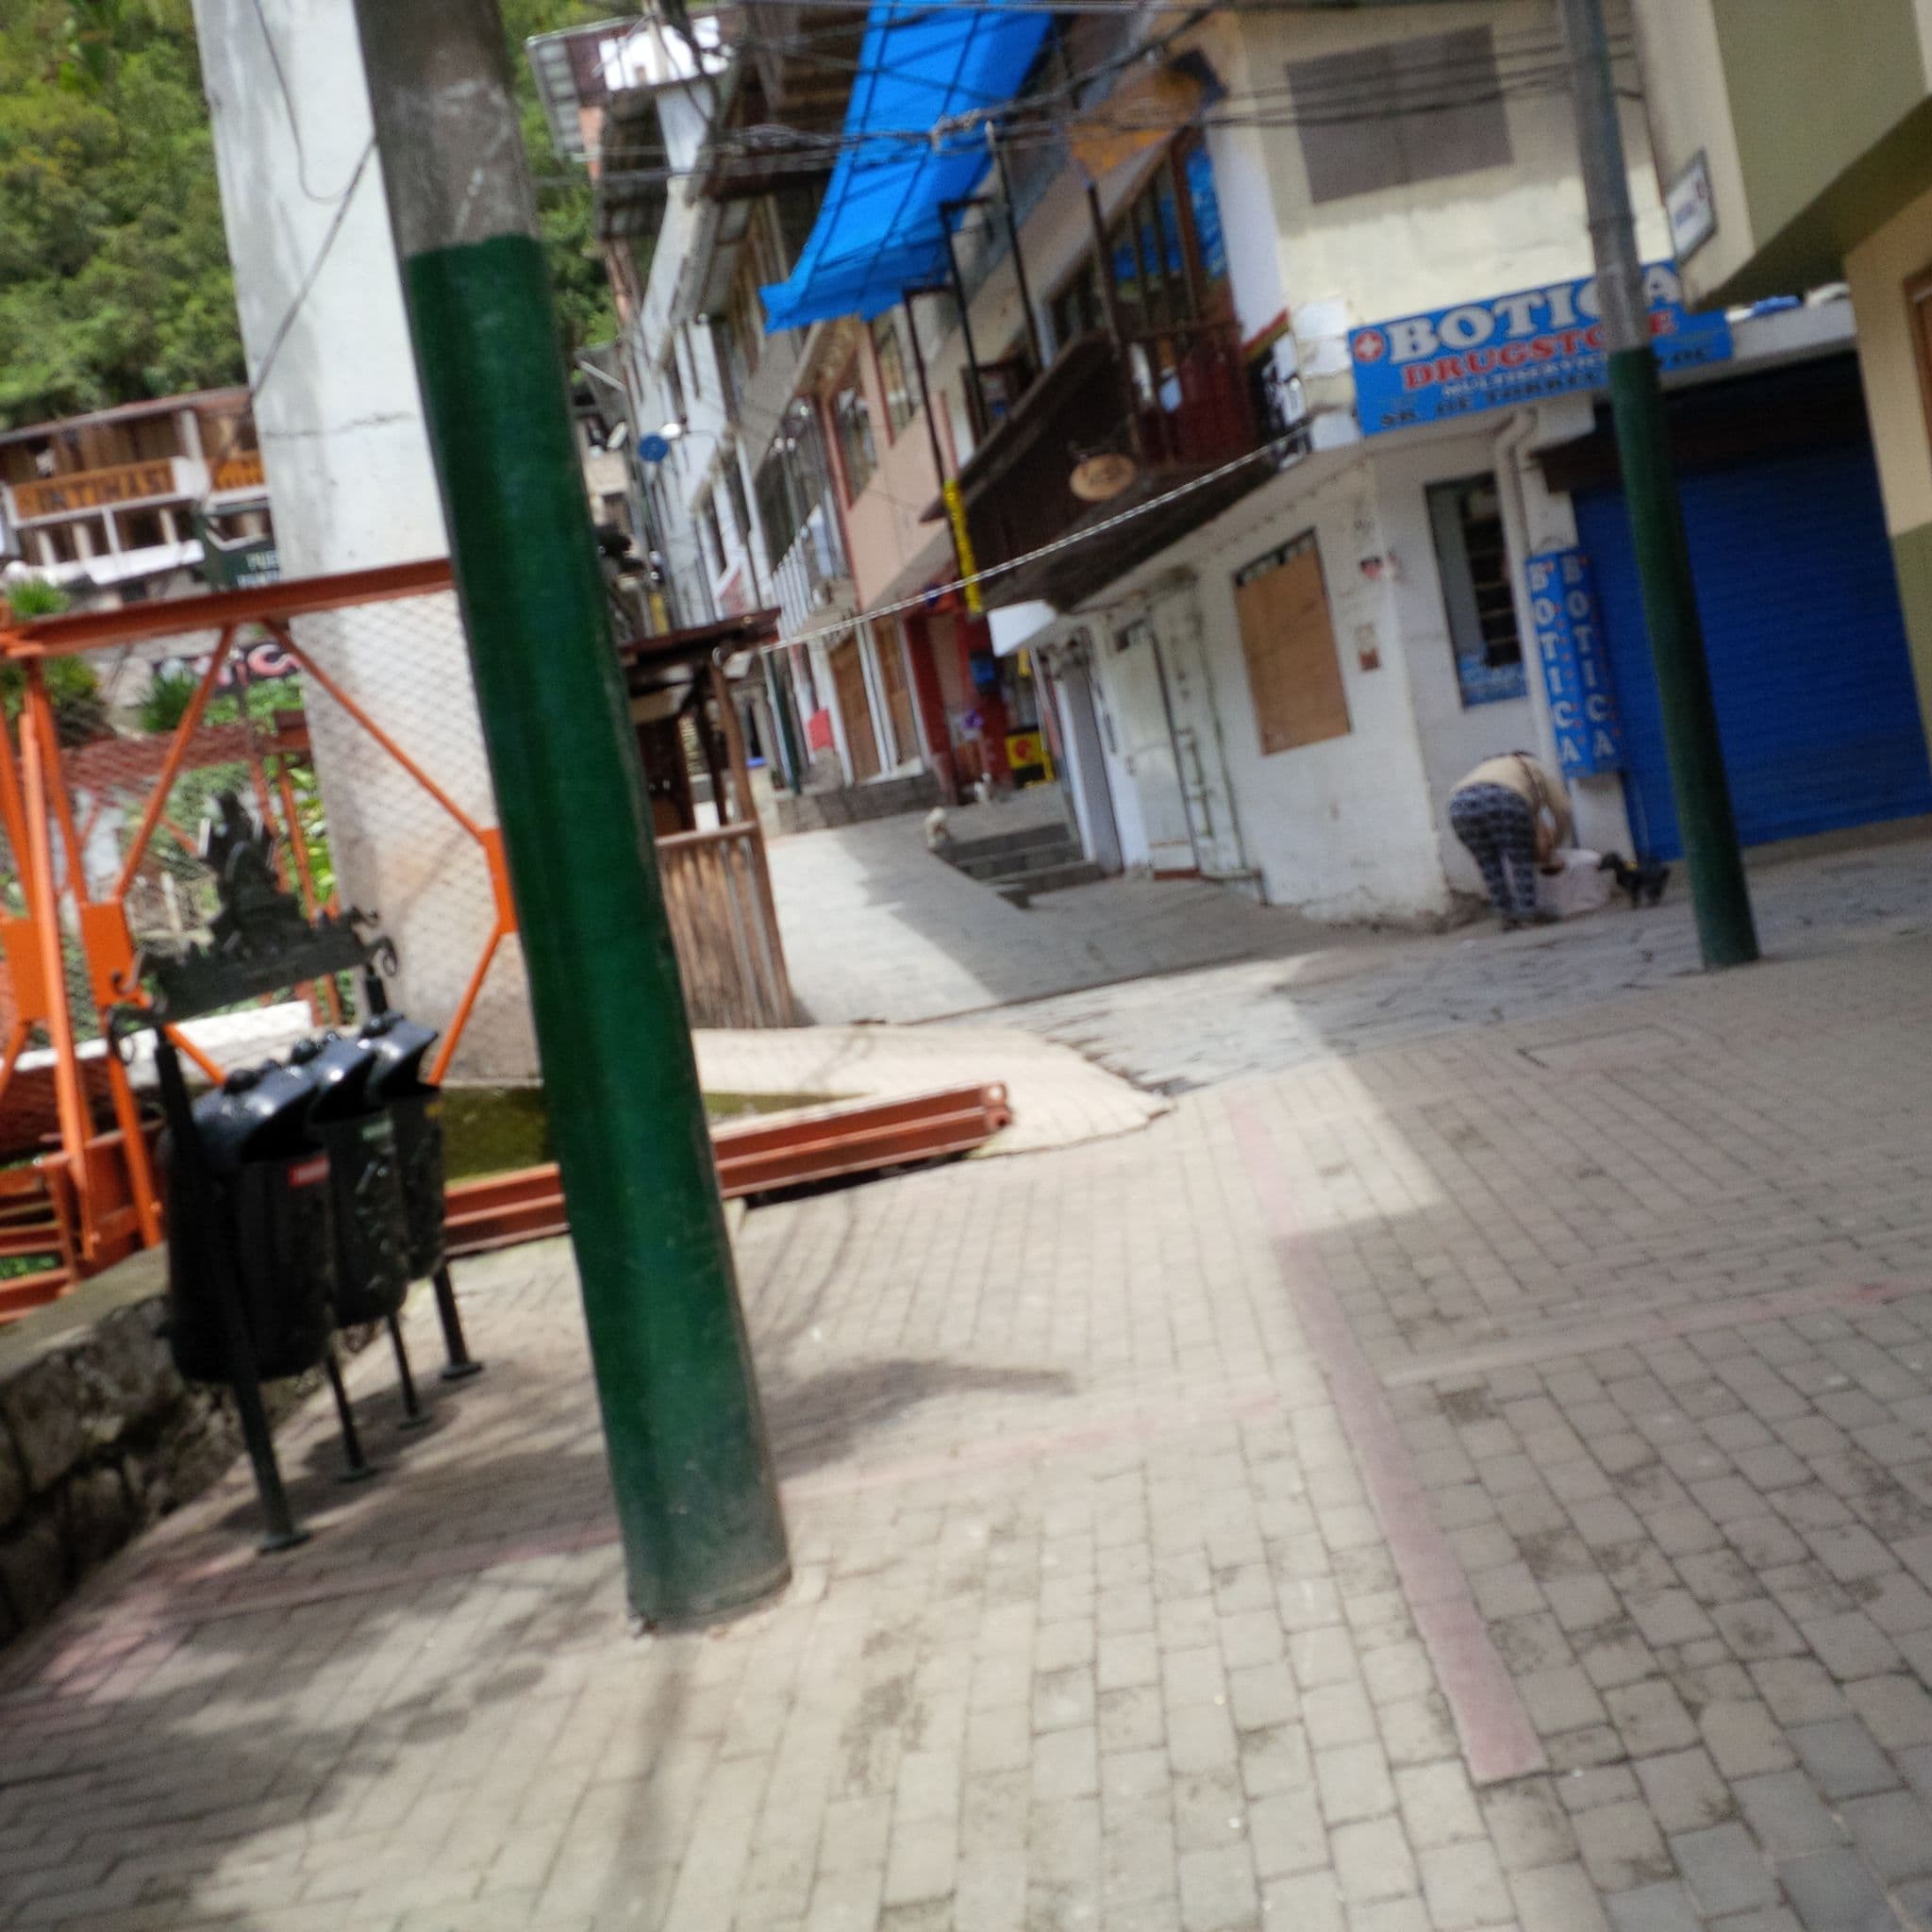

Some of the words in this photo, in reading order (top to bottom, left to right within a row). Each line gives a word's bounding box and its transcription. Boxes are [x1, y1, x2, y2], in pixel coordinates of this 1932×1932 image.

[1403, 309, 1676, 391] DRUGSTOE
[1528, 562, 1582, 763] BOTICA
[1560, 555, 1616, 758] BOTICA
